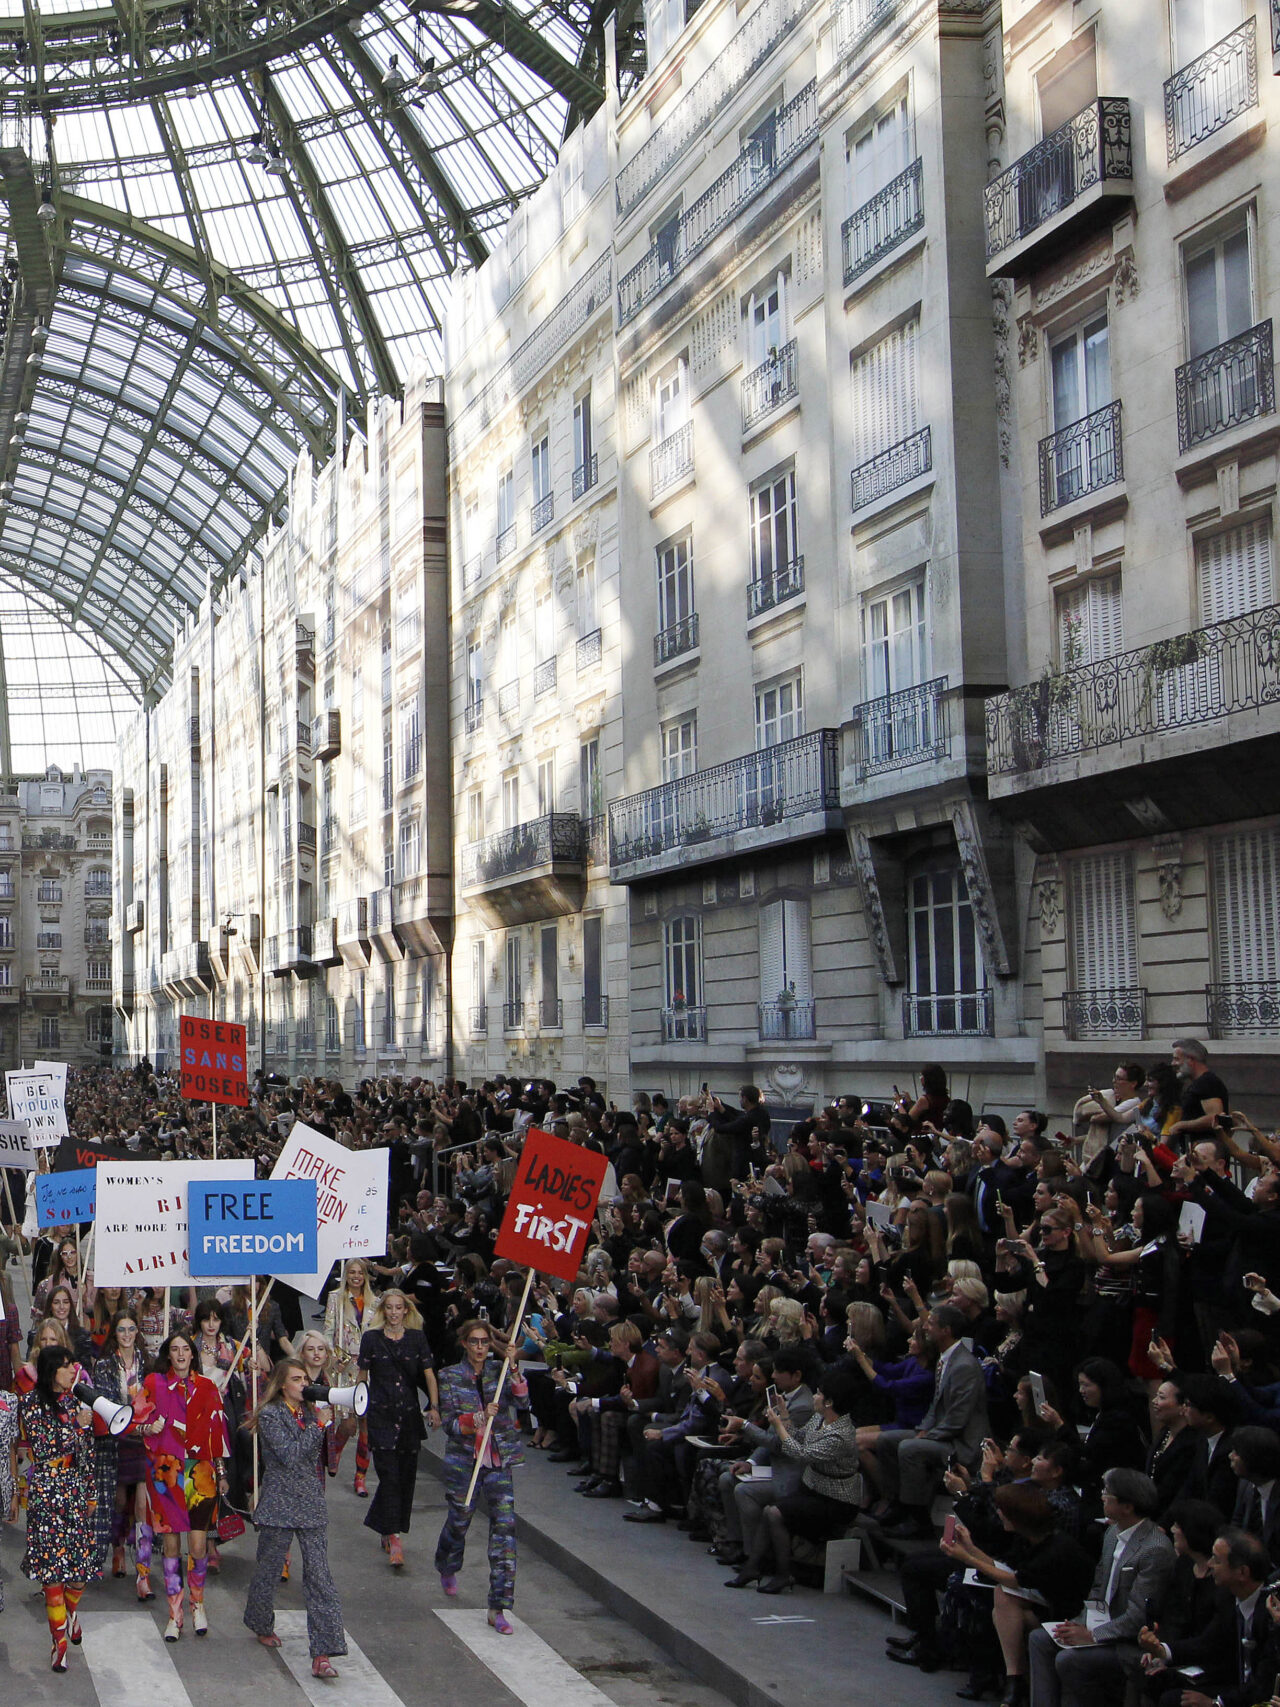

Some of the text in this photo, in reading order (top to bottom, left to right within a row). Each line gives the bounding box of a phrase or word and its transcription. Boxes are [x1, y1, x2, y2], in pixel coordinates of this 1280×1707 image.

[184, 1021, 241, 1044] OSER
[185, 1048, 243, 1072] SANS
[27, 1085, 47, 1097] BE
[182, 1073, 246, 1099] POSER
[16, 1098, 60, 1113] YOUR
[106, 1176, 164, 1186] WOMEN'S
[291, 1147, 346, 1193] MAKE
[204, 1193, 274, 1221] FREE
[104, 1224, 129, 1234] ARE
[134, 1224, 168, 1233] MORE
[203, 1232, 304, 1254] FREEDOM
